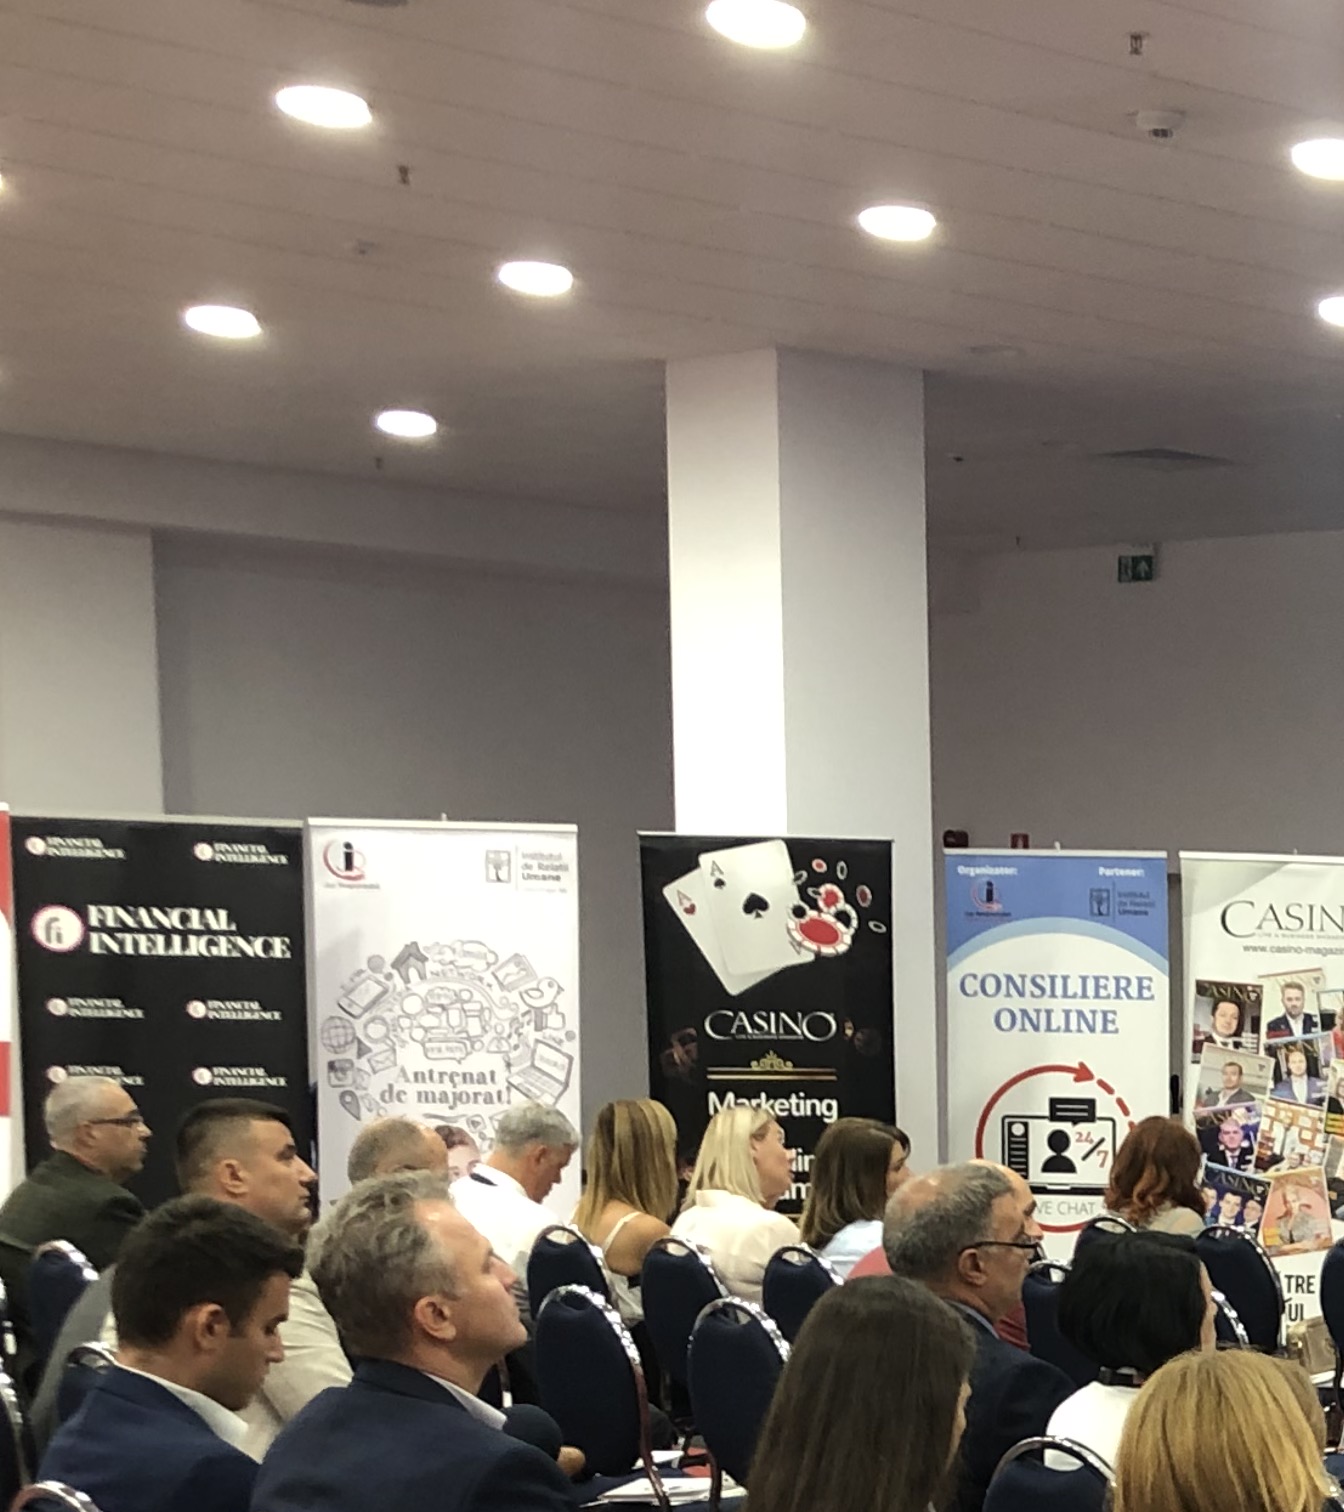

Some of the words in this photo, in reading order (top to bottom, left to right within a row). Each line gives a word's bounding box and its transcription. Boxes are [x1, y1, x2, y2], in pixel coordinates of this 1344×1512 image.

[86, 904, 237, 931] FINANCIAL
[89, 931, 292, 959] INTELLIGENCE
[959, 973, 1155, 1001] CONSILIERE
[703, 1010, 838, 1042] CASINO
[993, 1007, 1119, 1034] ONLINE
[379, 1083, 408, 1105] de
[1057, 1200, 1096, 1216] CHAT
